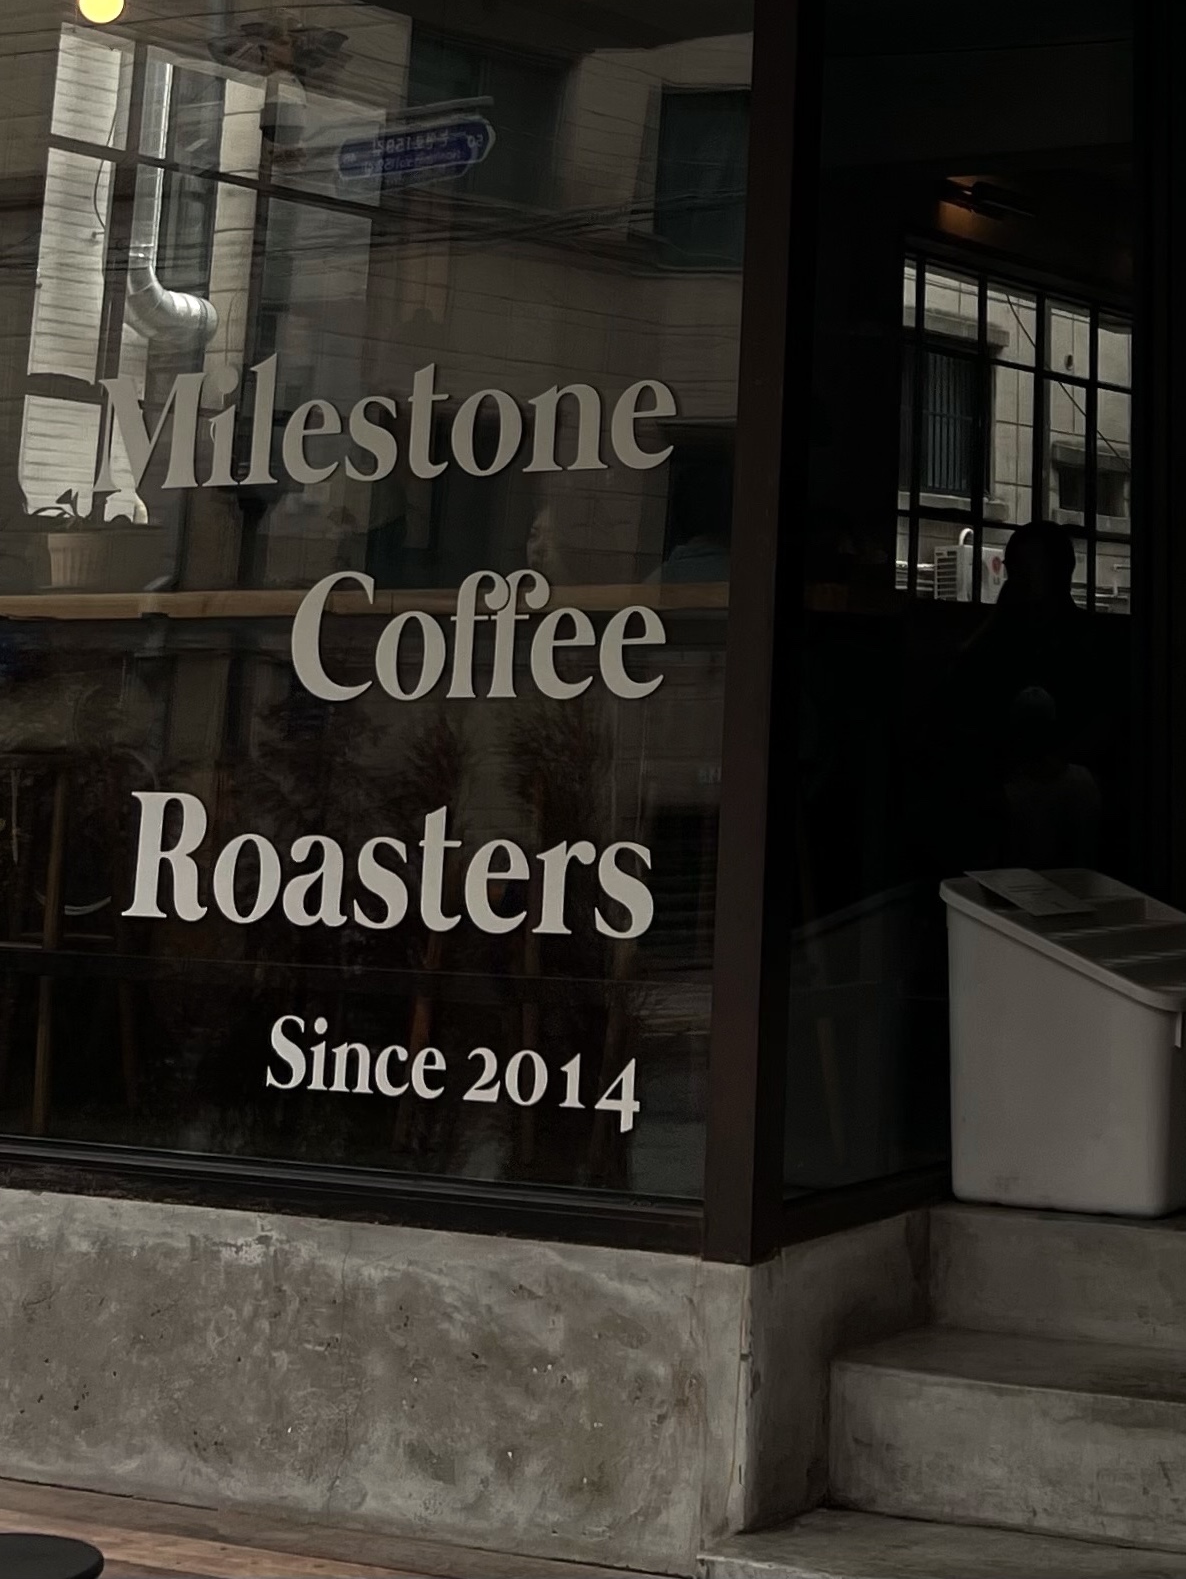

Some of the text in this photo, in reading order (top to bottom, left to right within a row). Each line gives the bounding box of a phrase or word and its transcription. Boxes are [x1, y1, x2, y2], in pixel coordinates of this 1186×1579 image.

[92, 351, 679, 491] Milestone
[290, 568, 667, 702] Coffee
[121, 790, 655, 940] Roasters
[264, 1014, 641, 1134] Since 2014
